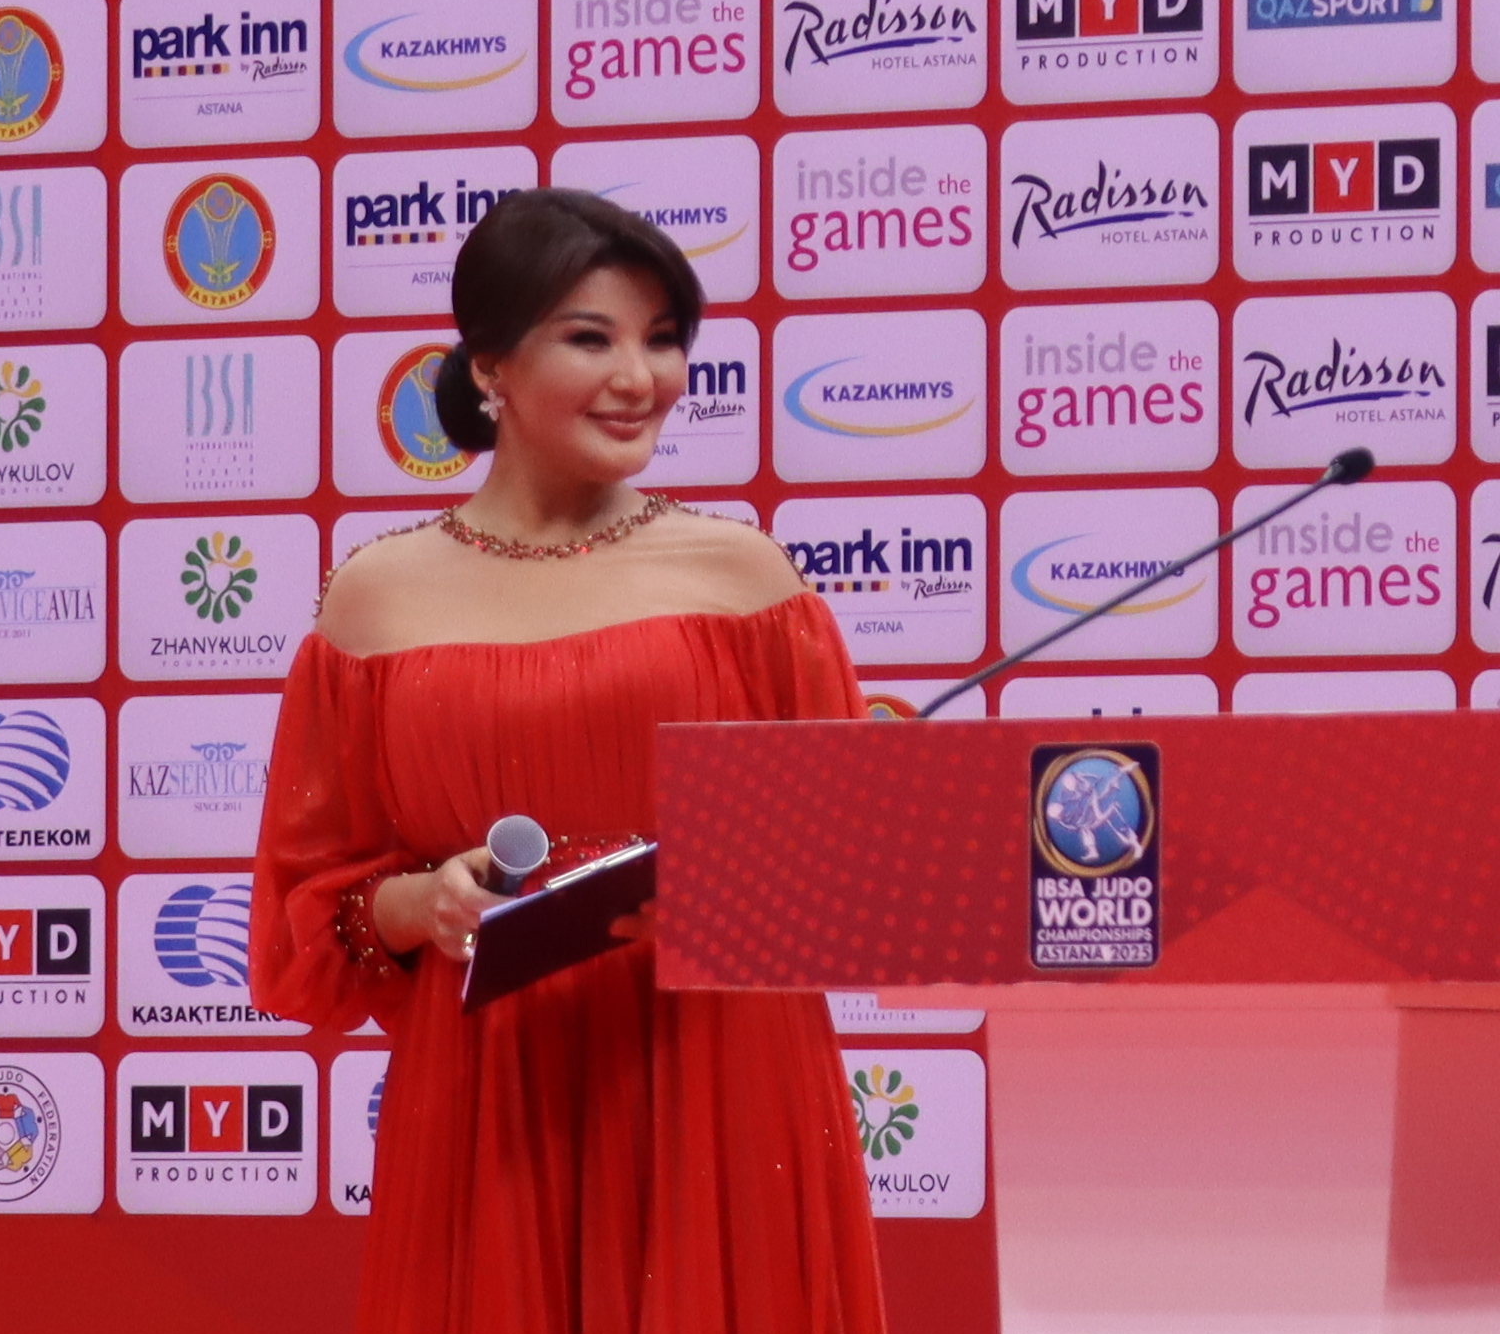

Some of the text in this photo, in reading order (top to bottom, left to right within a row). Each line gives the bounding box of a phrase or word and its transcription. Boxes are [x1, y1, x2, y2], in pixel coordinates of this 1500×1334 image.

[133, 11, 308, 79] park inn
[381, 36, 507, 58] KAZAKHMYS
[871, 53, 977, 70] HOTEL ASTANA
[197, 102, 244, 116] ASTANA
[1261, 150, 1425, 202] MYD
[1254, 225, 1434, 246] PRODUCTION
[1025, 331, 1202, 377] inside the
[822, 381, 953, 402] KAZAKHMYS
[1014, 382, 1204, 449] games
[1037, 877, 1152, 898] IBSA JUDO
[1037, 899, 1152, 927] WORLD
[1037, 928, 1152, 942] CHAMPIONSHIPS
[1040, 945, 1150, 961] ASTANA 2025
